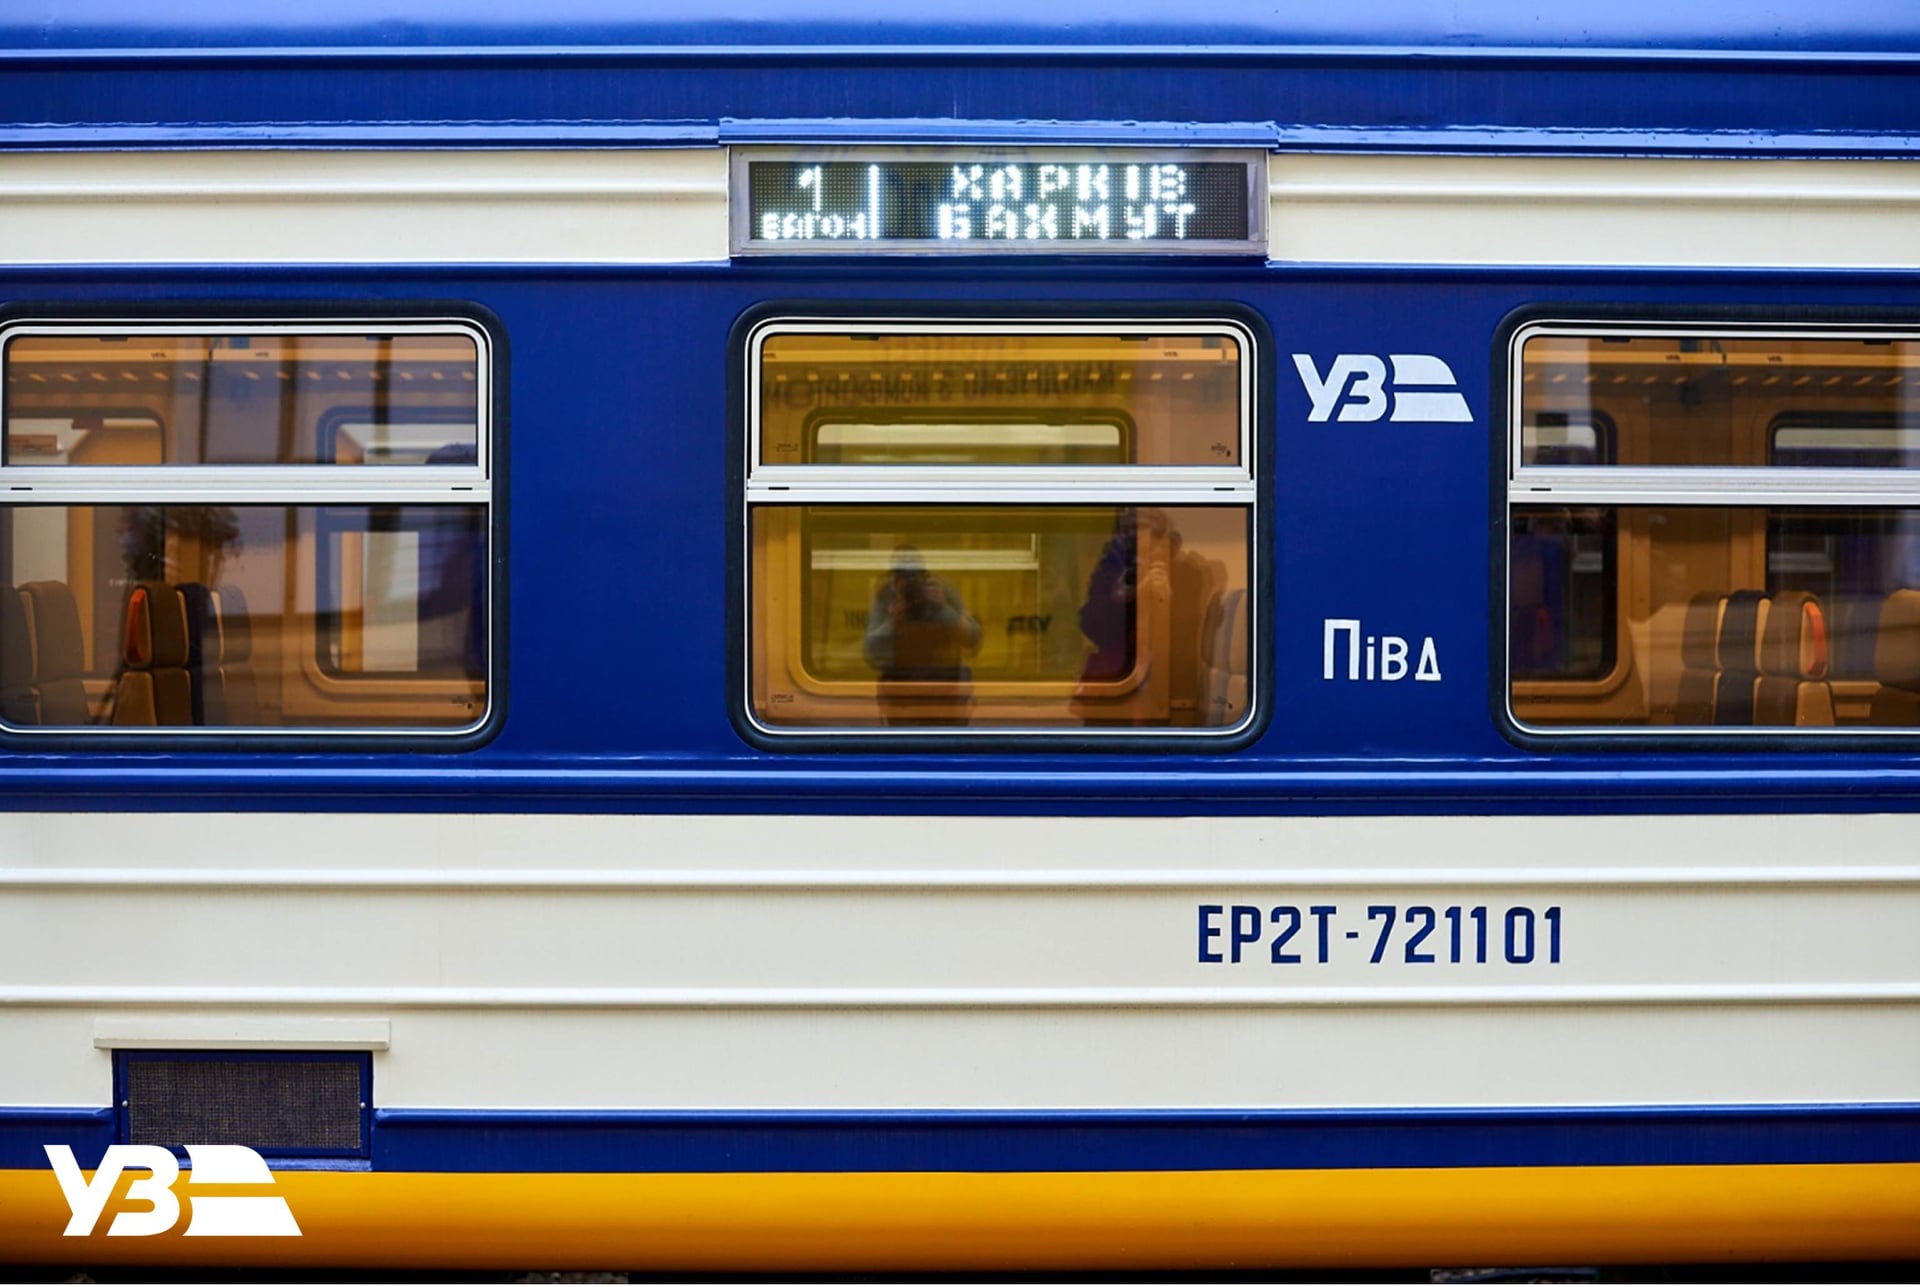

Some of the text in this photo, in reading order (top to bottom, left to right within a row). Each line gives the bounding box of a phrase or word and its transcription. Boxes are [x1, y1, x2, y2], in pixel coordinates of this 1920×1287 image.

[799, 164, 823, 213] 1
[951, 164, 1187, 201] ХАРКІВ
[937, 203, 1196, 240] БАХМУТ
